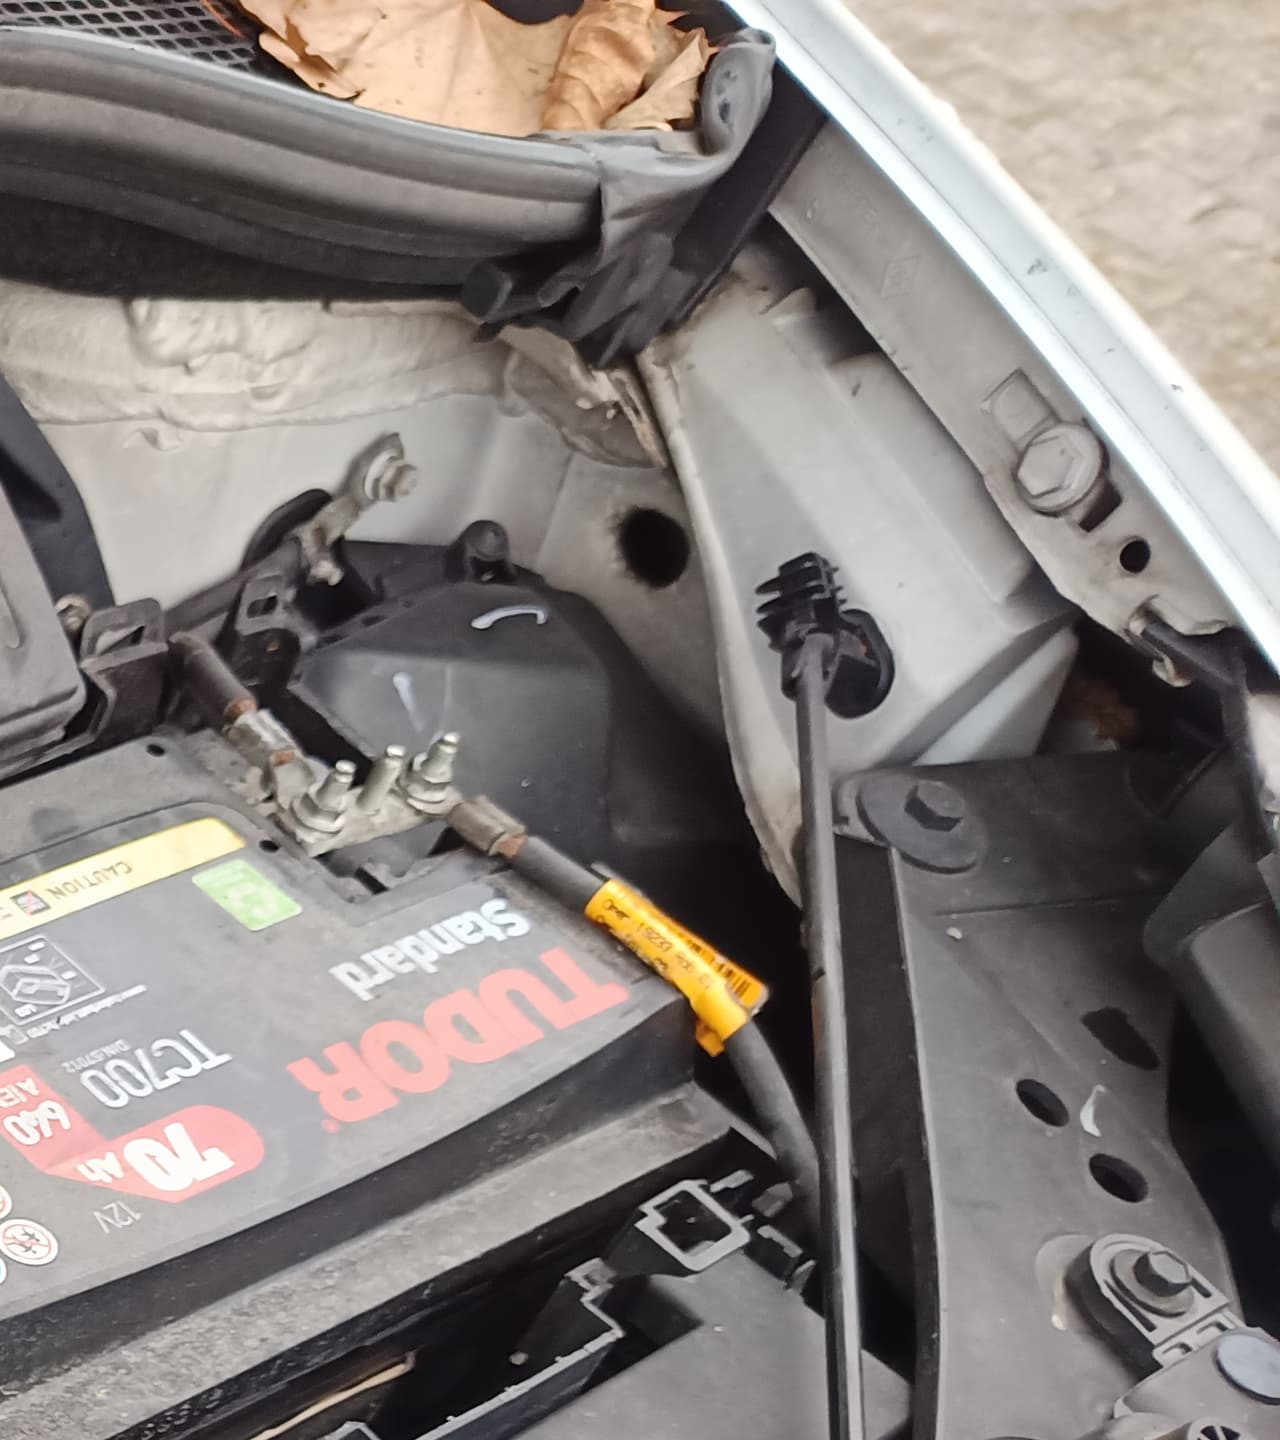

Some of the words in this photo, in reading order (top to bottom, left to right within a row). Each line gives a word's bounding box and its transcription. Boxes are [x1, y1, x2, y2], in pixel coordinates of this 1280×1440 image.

[42, 856, 135, 901] CAUTION
[329, 896, 531, 1001] Standard
[73, 1022, 231, 1112] TC700
[283, 944, 631, 1127] TUDOR
[73, 1149, 132, 1189] Ah
[116, 1115, 235, 1197] 70
[86, 1196, 144, 1234] 12V
